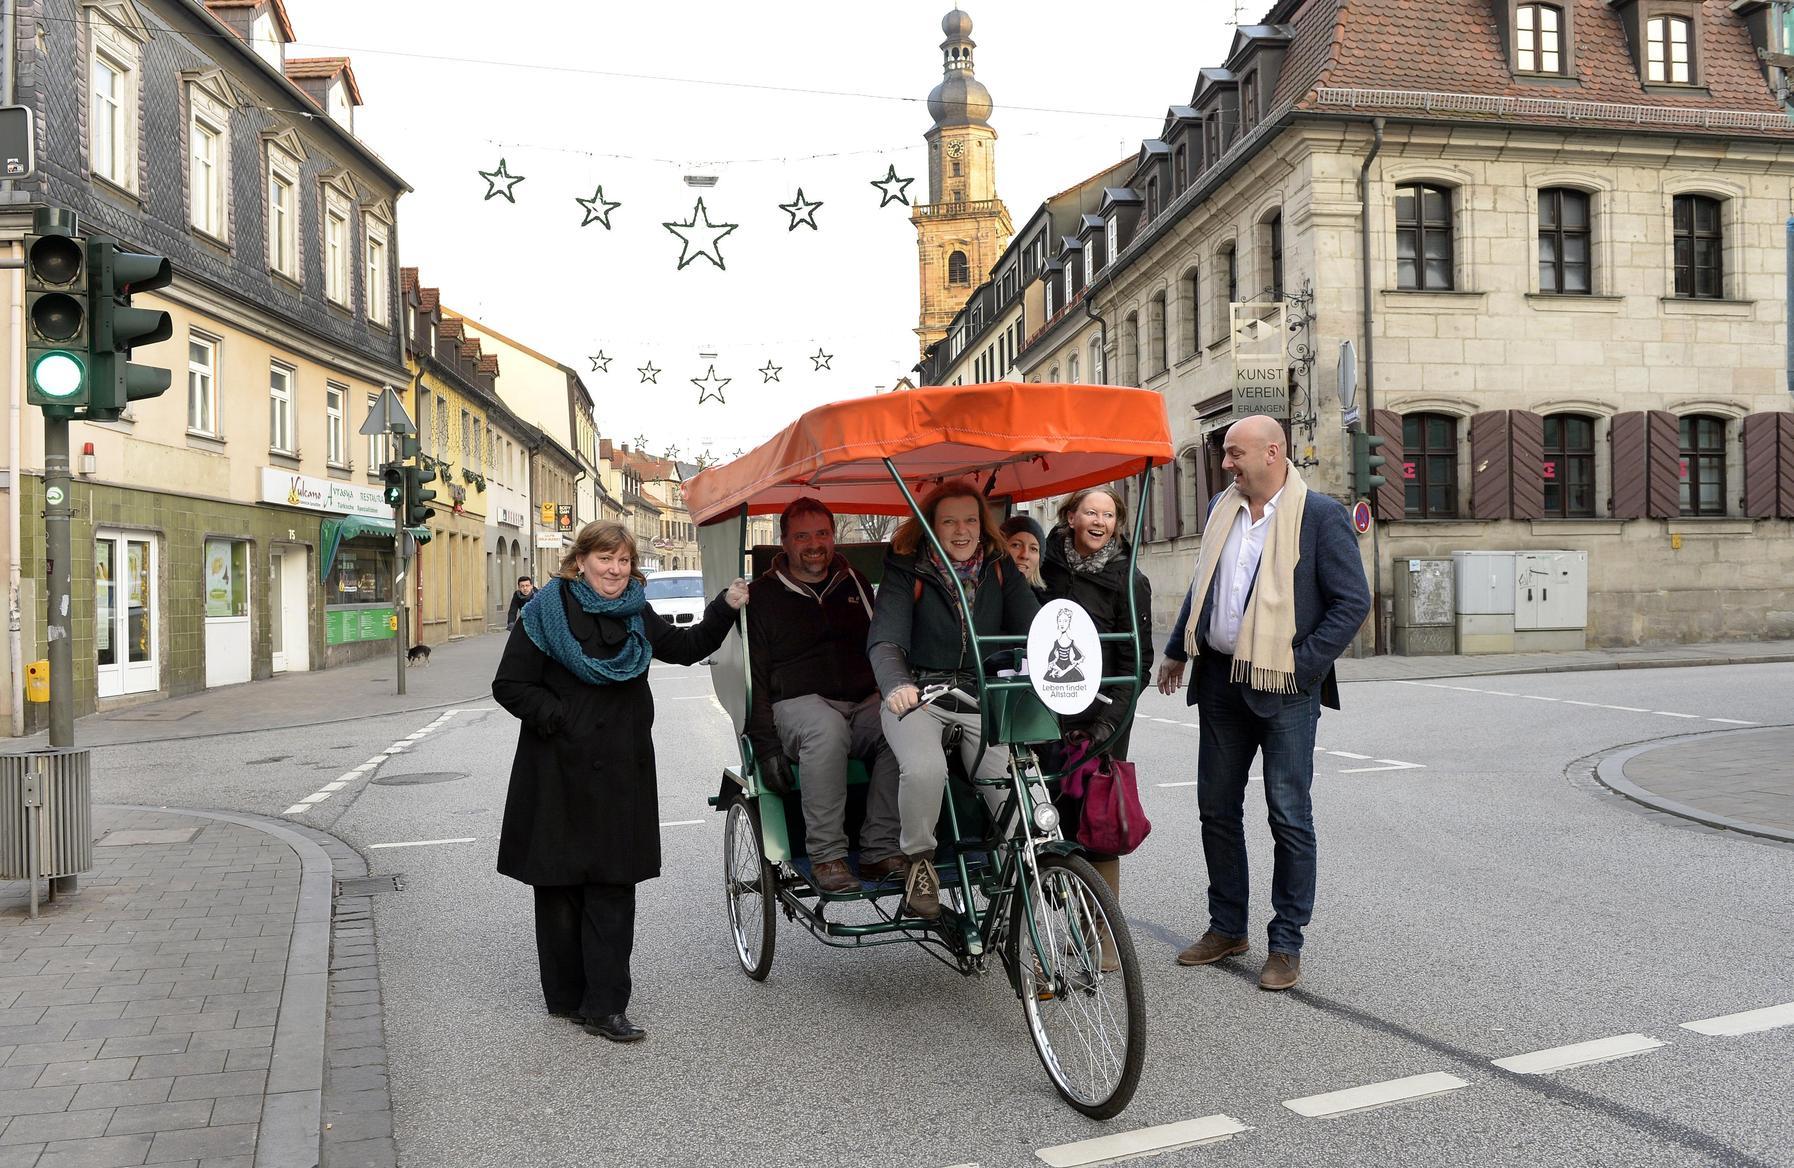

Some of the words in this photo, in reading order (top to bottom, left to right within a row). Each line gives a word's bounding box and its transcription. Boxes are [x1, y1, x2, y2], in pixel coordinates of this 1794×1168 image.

[1237, 369, 1283, 380] KUNST
[1237, 387, 1285, 398] VEREIN
[1237, 404, 1285, 413] ERLANGEN
[360, 492, 385, 503] RESTAURA
[288, 529, 295, 540] 15
